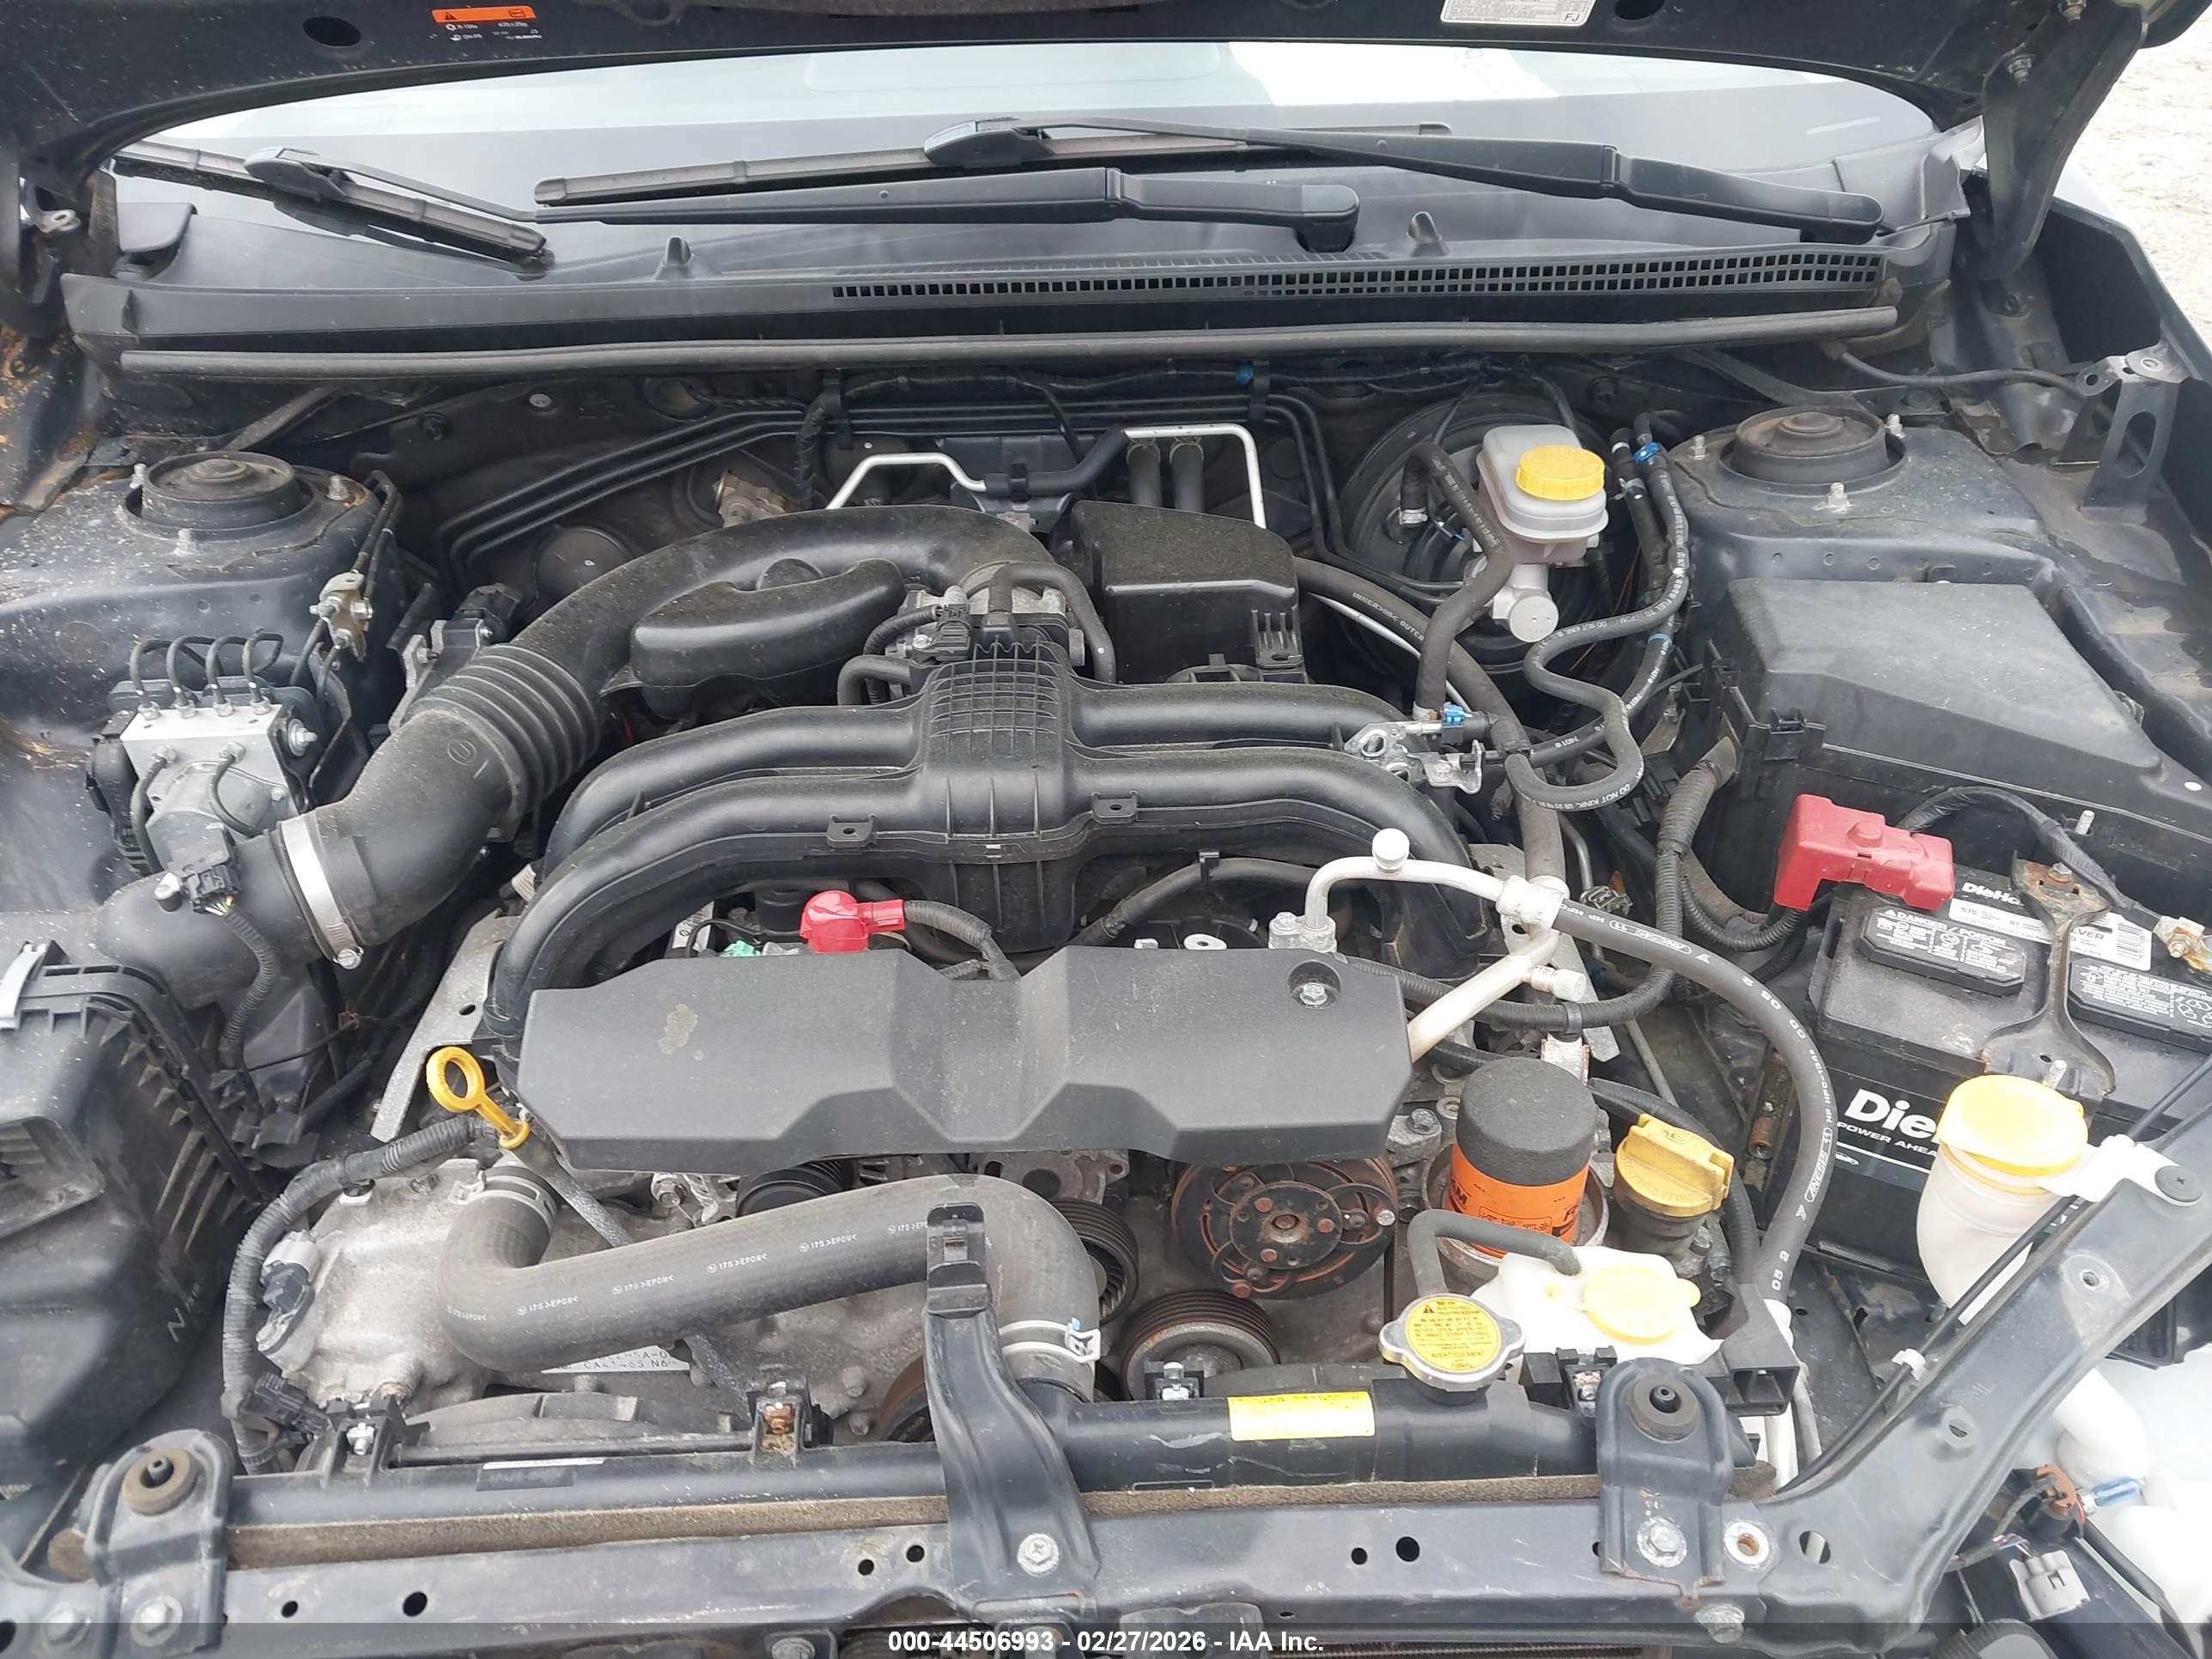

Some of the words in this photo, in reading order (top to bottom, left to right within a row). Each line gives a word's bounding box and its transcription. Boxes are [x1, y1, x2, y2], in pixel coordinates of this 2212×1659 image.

[1563, 13, 1581, 22] FJ
[1619, 783, 1631, 796] DO
[1601, 791, 1619, 804] NOT
[1896, 911, 1948, 932] DANGER
[1959, 927, 2007, 946] POISON
[1836, 1121, 1893, 1144] POWER
